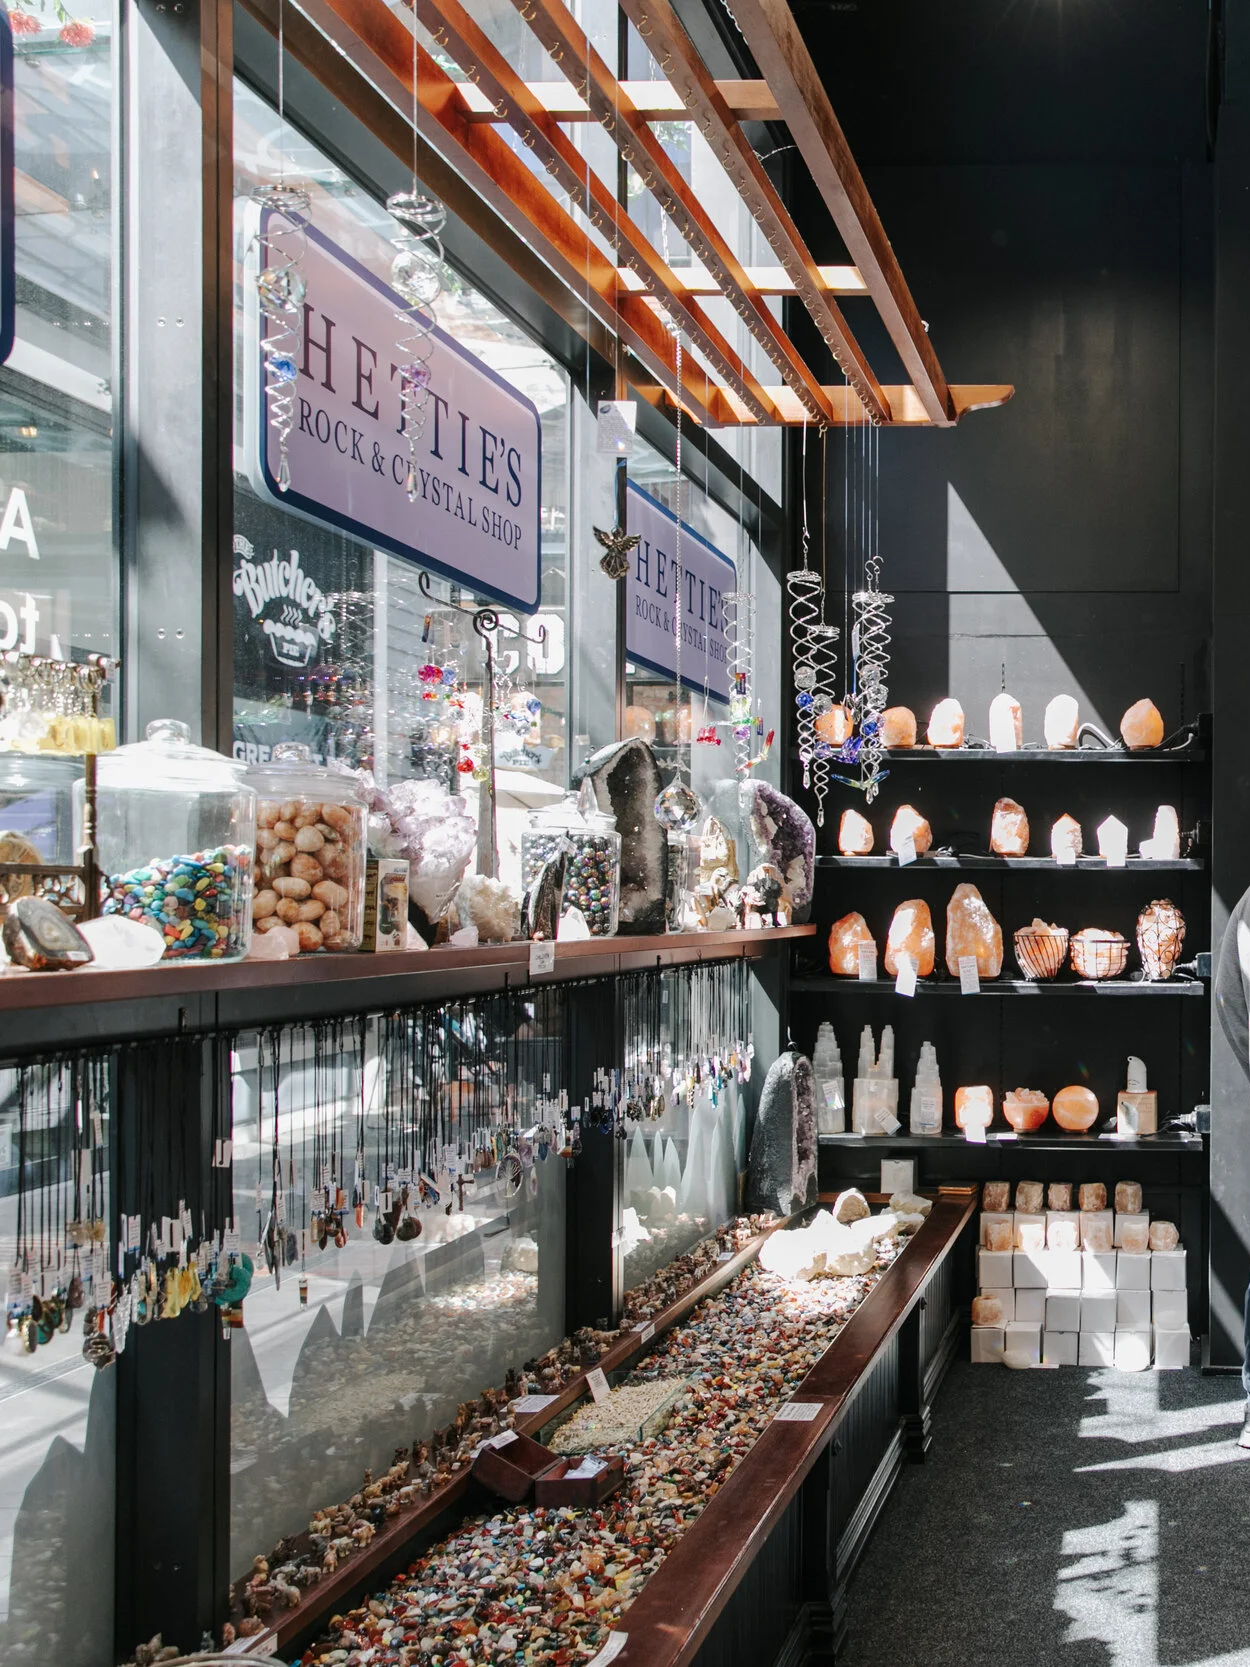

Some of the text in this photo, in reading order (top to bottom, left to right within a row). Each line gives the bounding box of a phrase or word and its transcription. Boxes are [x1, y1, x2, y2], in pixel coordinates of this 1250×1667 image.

[298, 396, 365, 466] ROCK
[371, 441, 386, 477] &
[481, 506, 522, 551] SHOP
[282, 642, 300, 657] PIE
[635, 594, 662, 628] ROCK
[663, 611, 670, 633] &
[671, 616, 706, 653] CYSTAL
